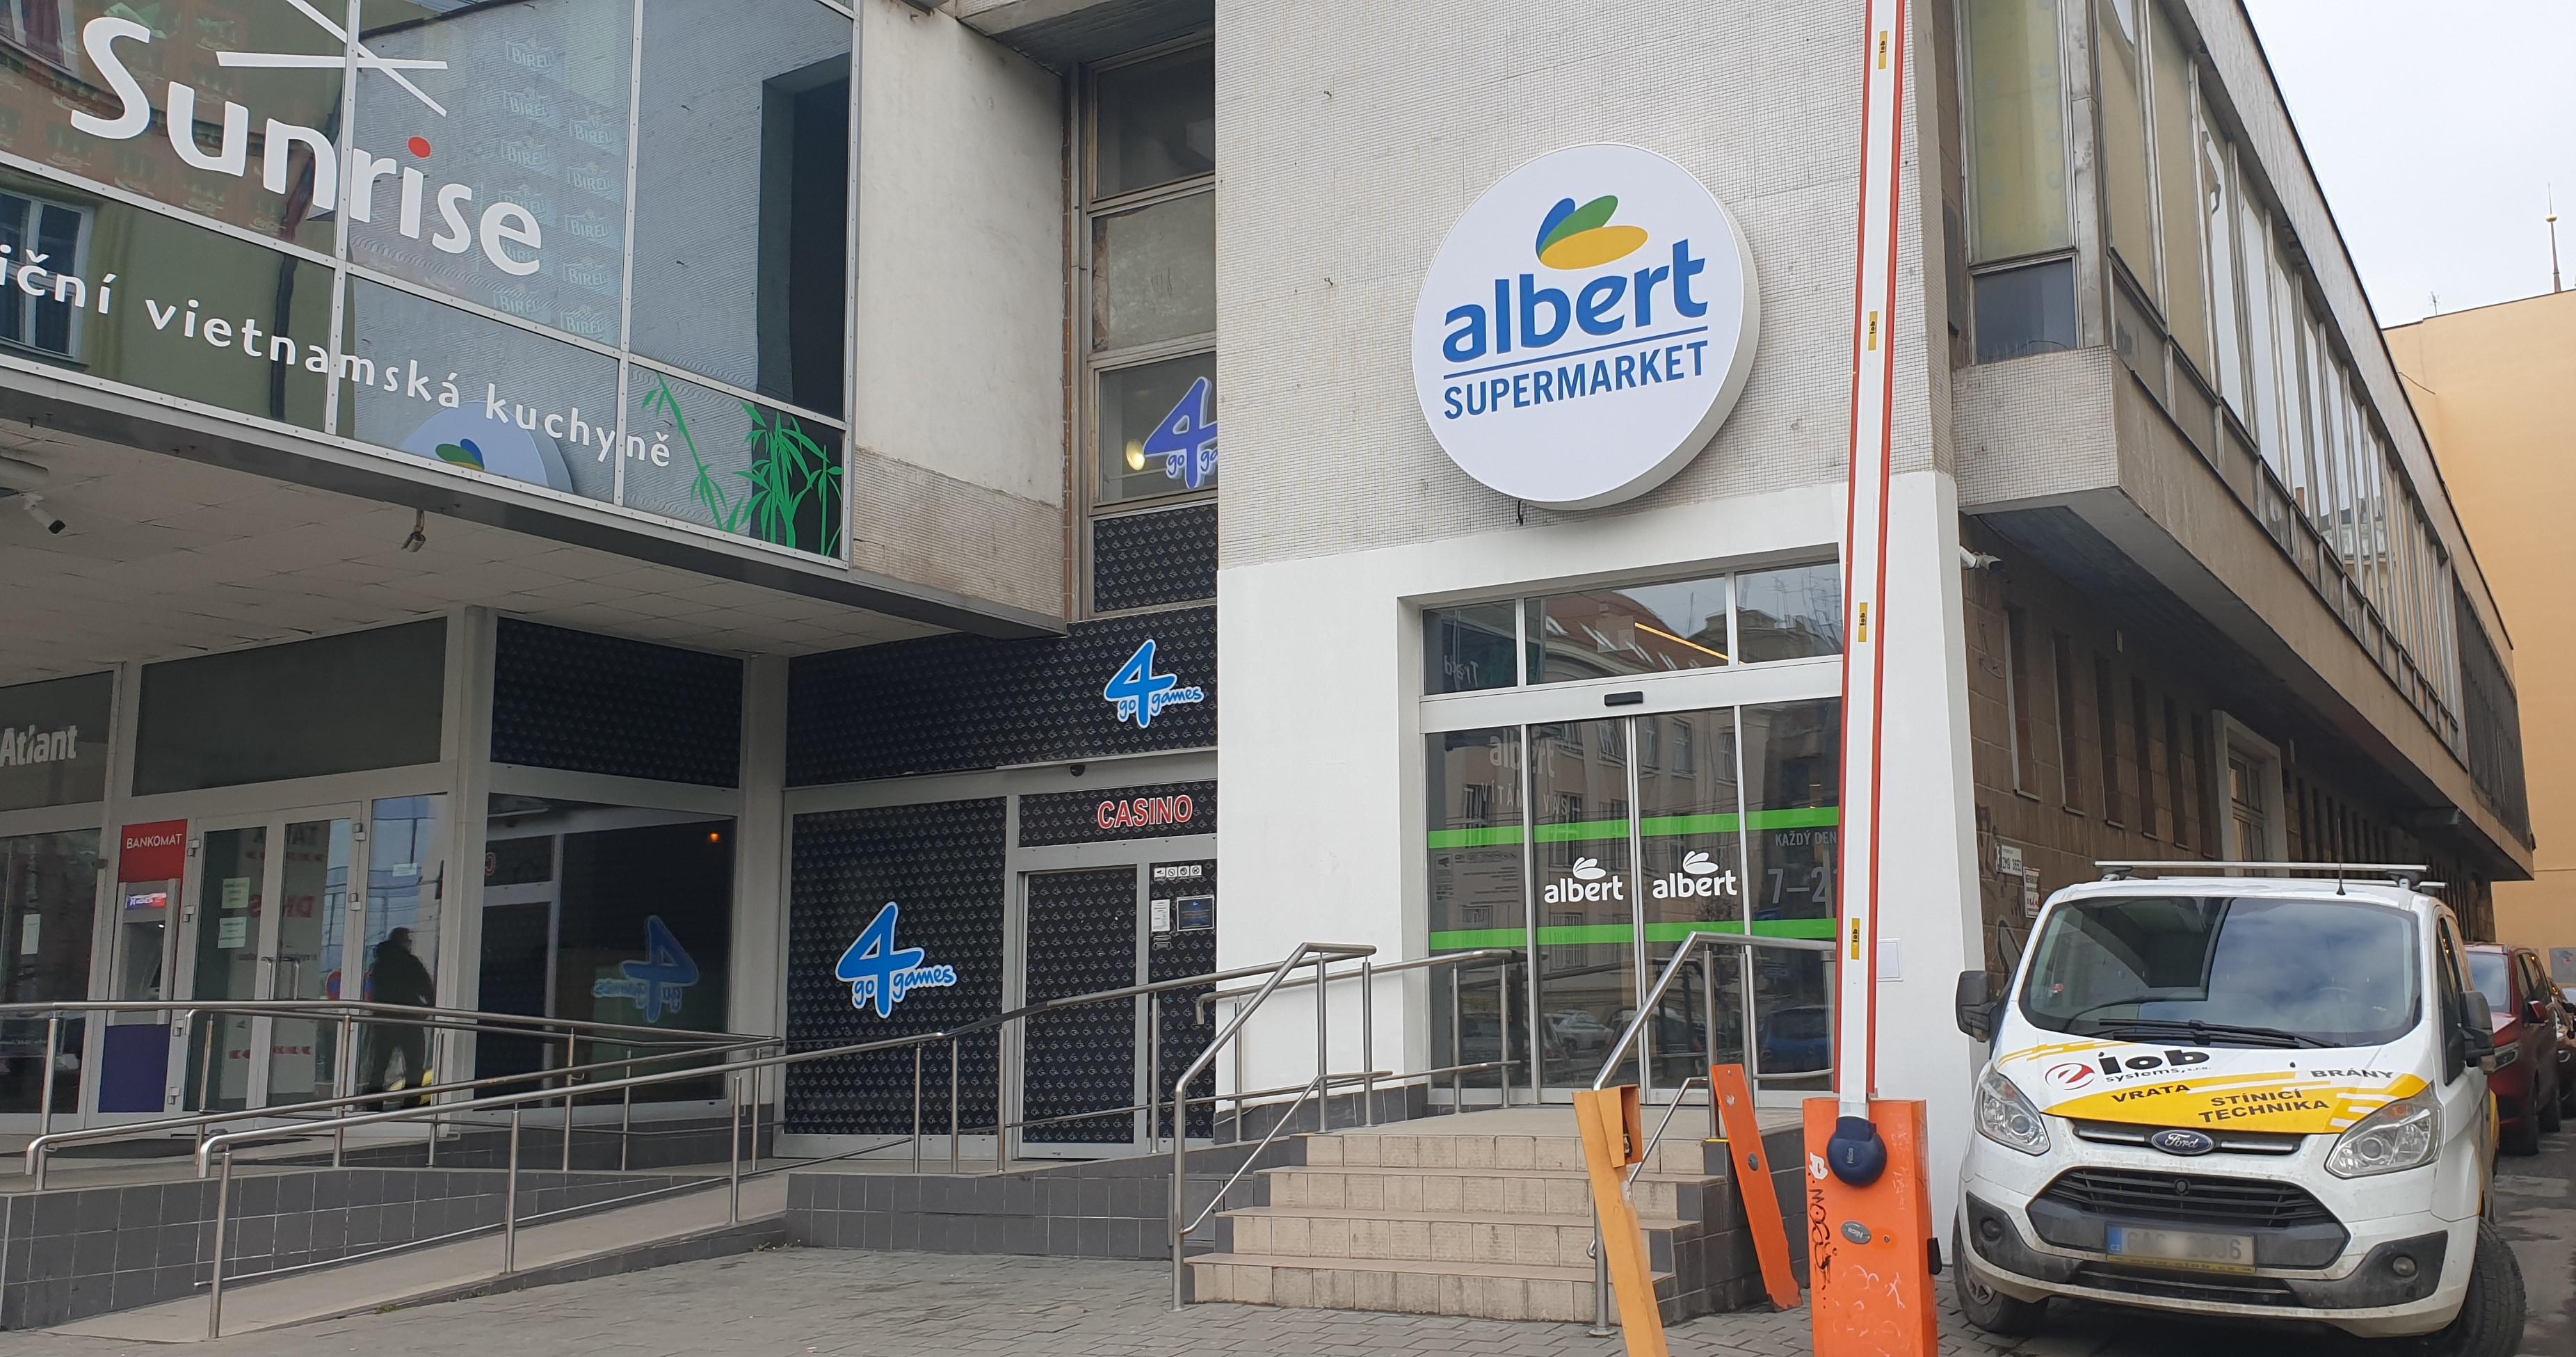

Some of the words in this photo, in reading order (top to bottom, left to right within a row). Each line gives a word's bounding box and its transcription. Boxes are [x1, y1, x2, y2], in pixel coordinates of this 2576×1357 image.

[71, 17, 542, 277] Sunrise
[1442, 239, 1708, 363] albert
[145, 299, 459, 408] vietnamská
[485, 383, 670, 467] kuchyně
[1444, 339, 1709, 420] SUPERMARKET
[1104, 639, 1177, 728] 4
[1119, 699, 1136, 719] go
[1150, 688, 1203, 714] games
[1097, 794, 1193, 829] CASINO
[127, 833, 182, 849] BANKOMAT
[1775, 829, 1812, 846] KAŽDÝ
[1814, 831, 1837, 845] DEN
[1544, 875, 1624, 903] albert
[1652, 870, 1738, 899] albert
[835, 901, 924, 1018] 4
[854, 979, 875, 1006] go
[892, 967, 954, 999] games
[2310, 1068, 2394, 1079] BRÁNY
[2111, 1084, 2191, 1102] VRATA
[2210, 1088, 2303, 1107] STÍNICÍ
[2198, 1100, 2330, 1123] TECHNIKA
[2165, 1133, 2199, 1148] Ford
[1847, 1226, 1864, 1240] Nice
